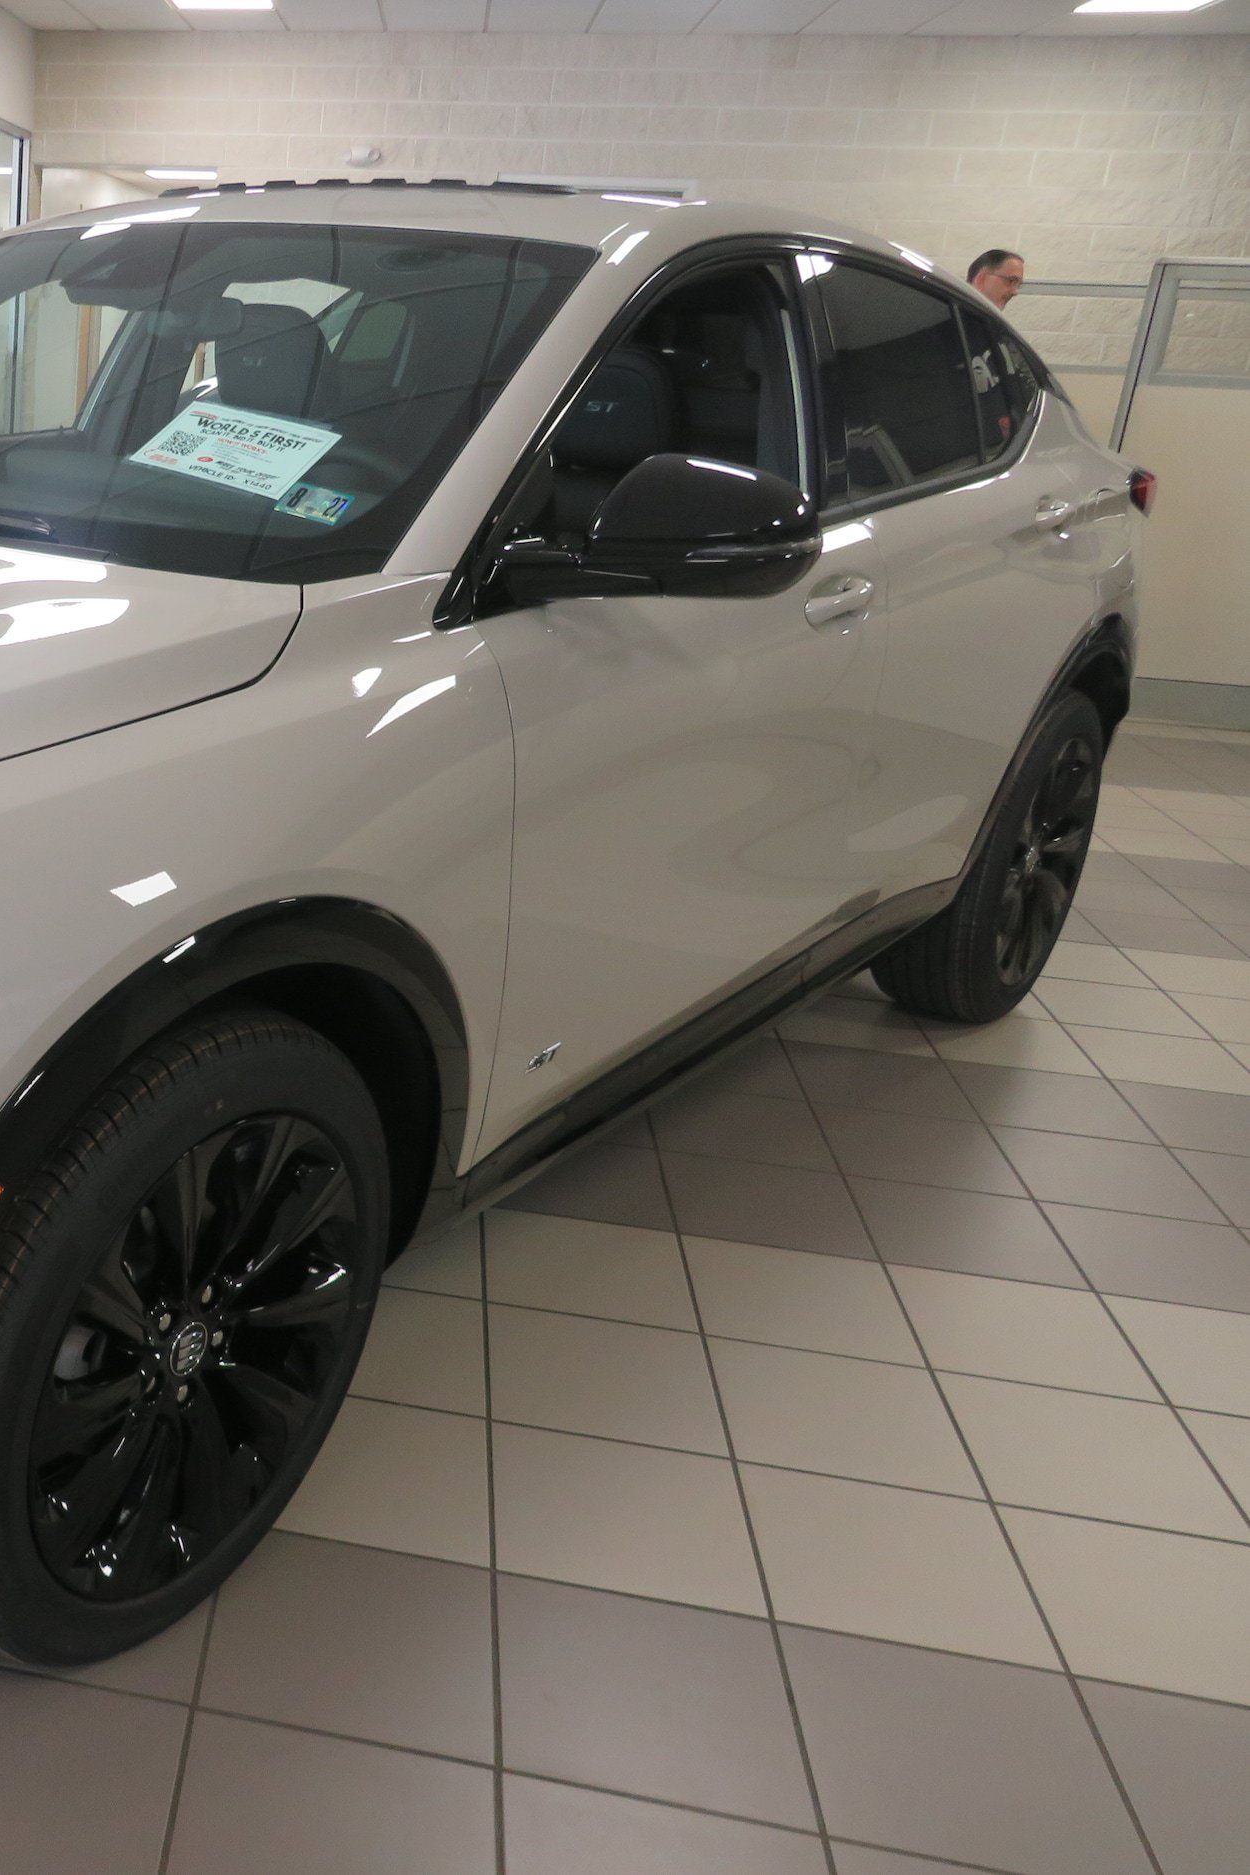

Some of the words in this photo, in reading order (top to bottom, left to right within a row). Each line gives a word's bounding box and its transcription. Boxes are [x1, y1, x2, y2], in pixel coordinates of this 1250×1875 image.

[584, 400, 620, 413] ST
[262, 432, 307, 451] FIRST!
[189, 465, 224, 478] VEHICLE
[286, 487, 308, 507] 8
[323, 497, 348, 517] 27
